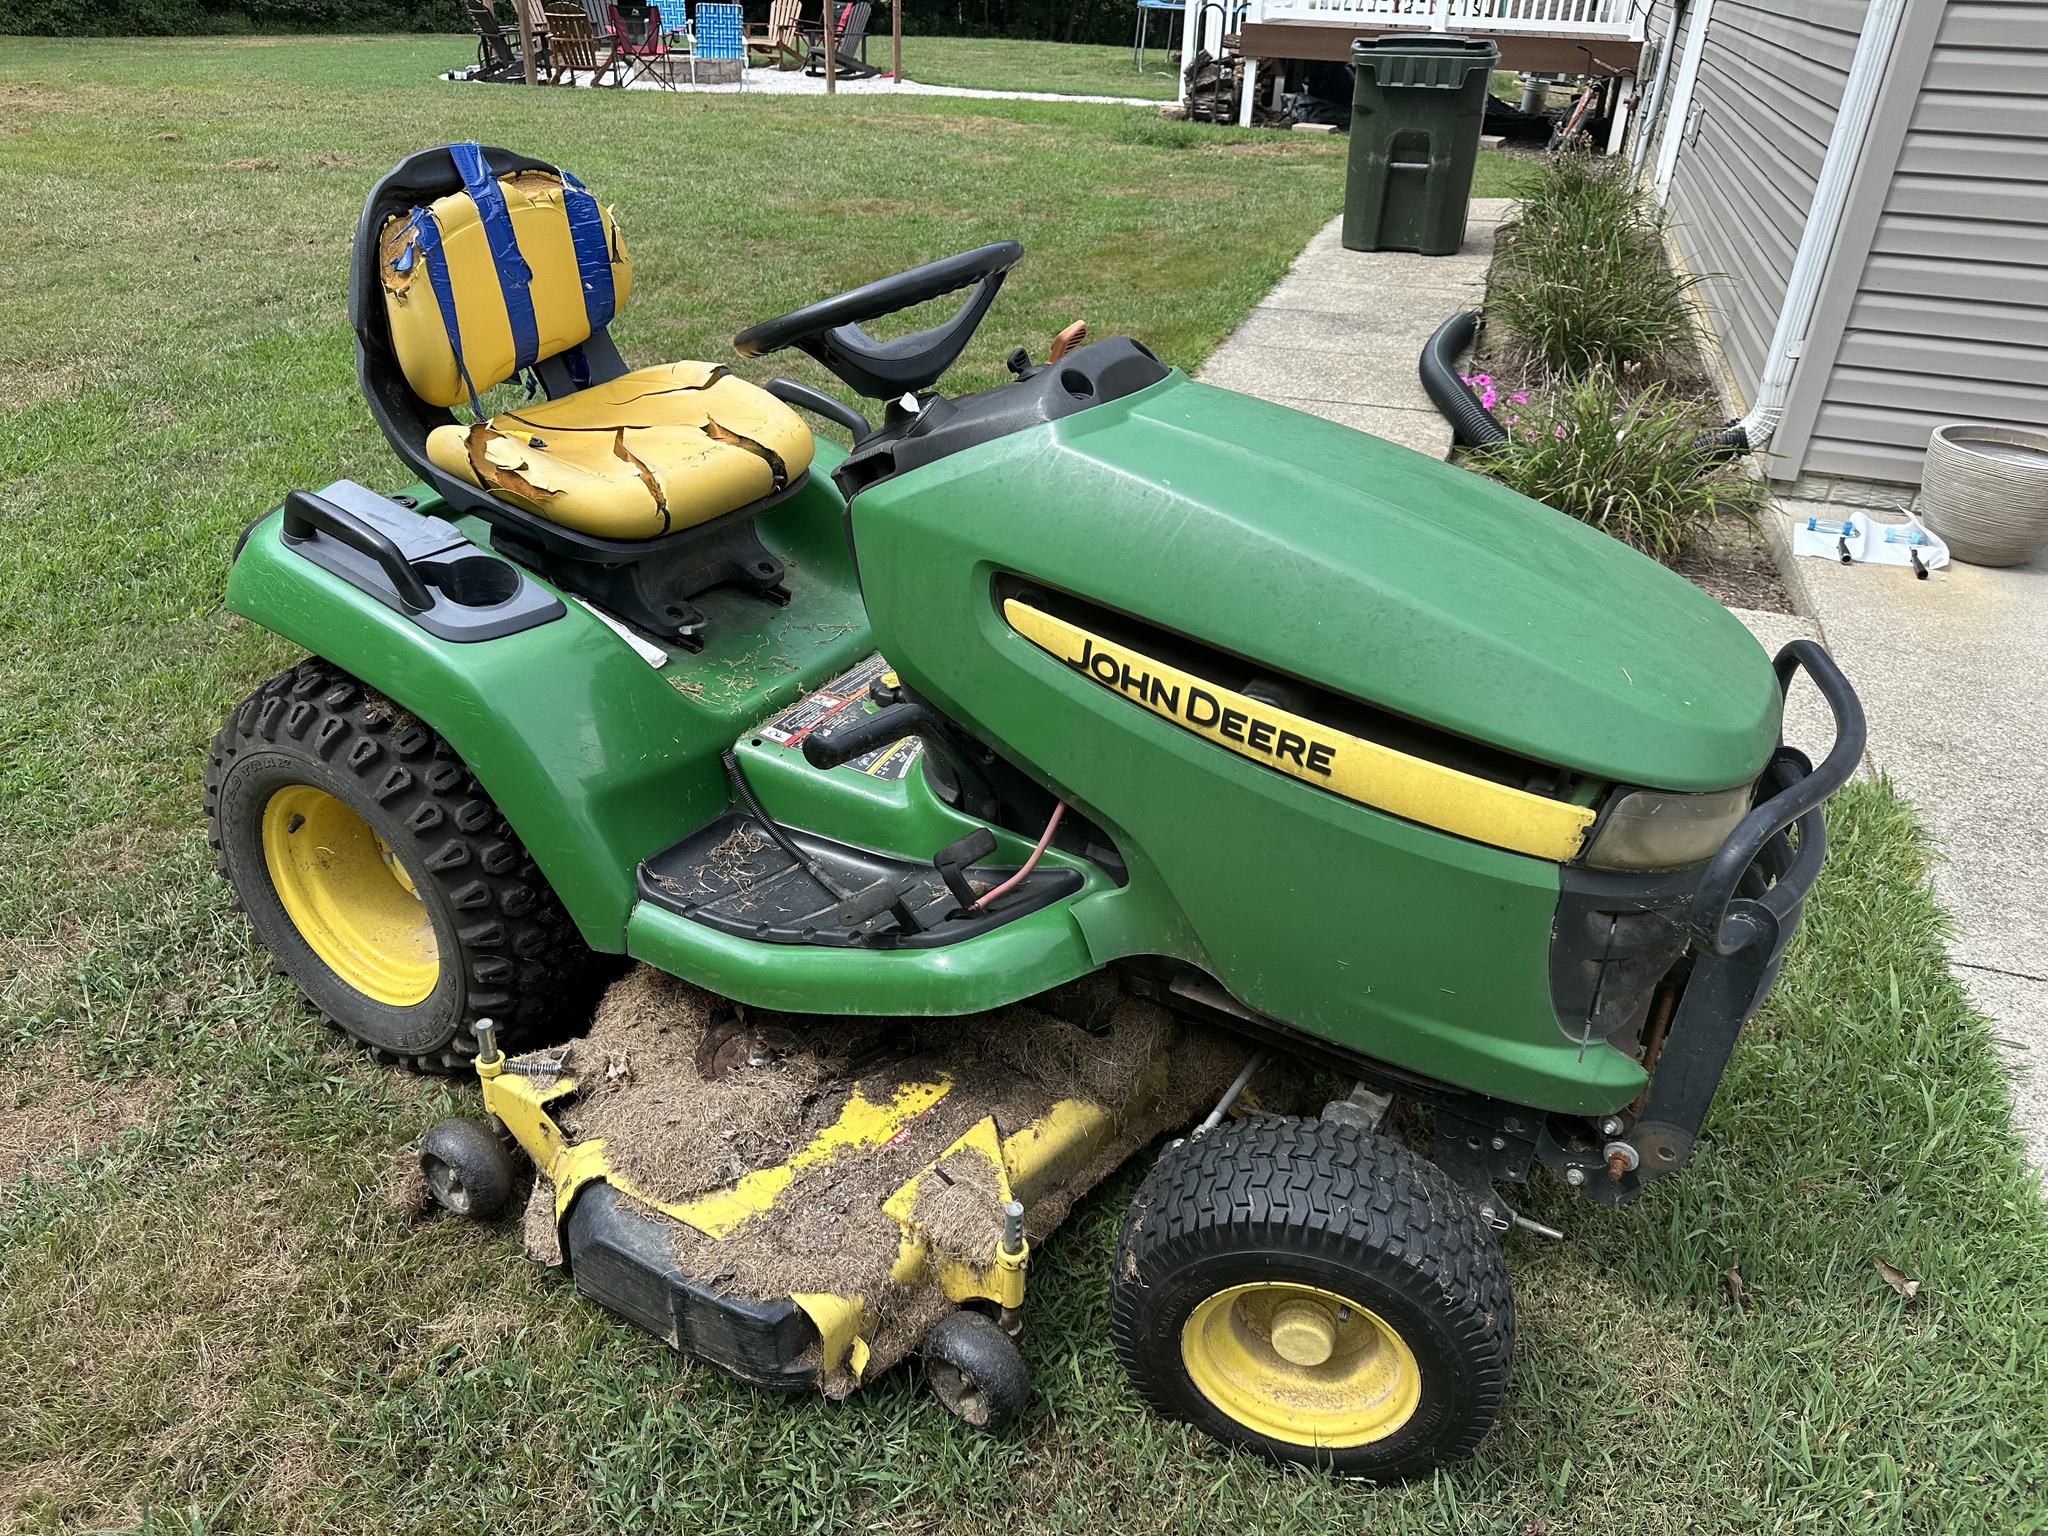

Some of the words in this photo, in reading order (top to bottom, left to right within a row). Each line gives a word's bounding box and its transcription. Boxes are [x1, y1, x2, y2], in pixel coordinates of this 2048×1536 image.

[1067, 638, 1179, 714] JOHN
[1185, 686, 1336, 776] DEERE
[240, 757, 292, 777] TRAX
[393, 966, 457, 1048] CARLISLE
[1158, 1278, 1216, 1338] CARLSTAR
